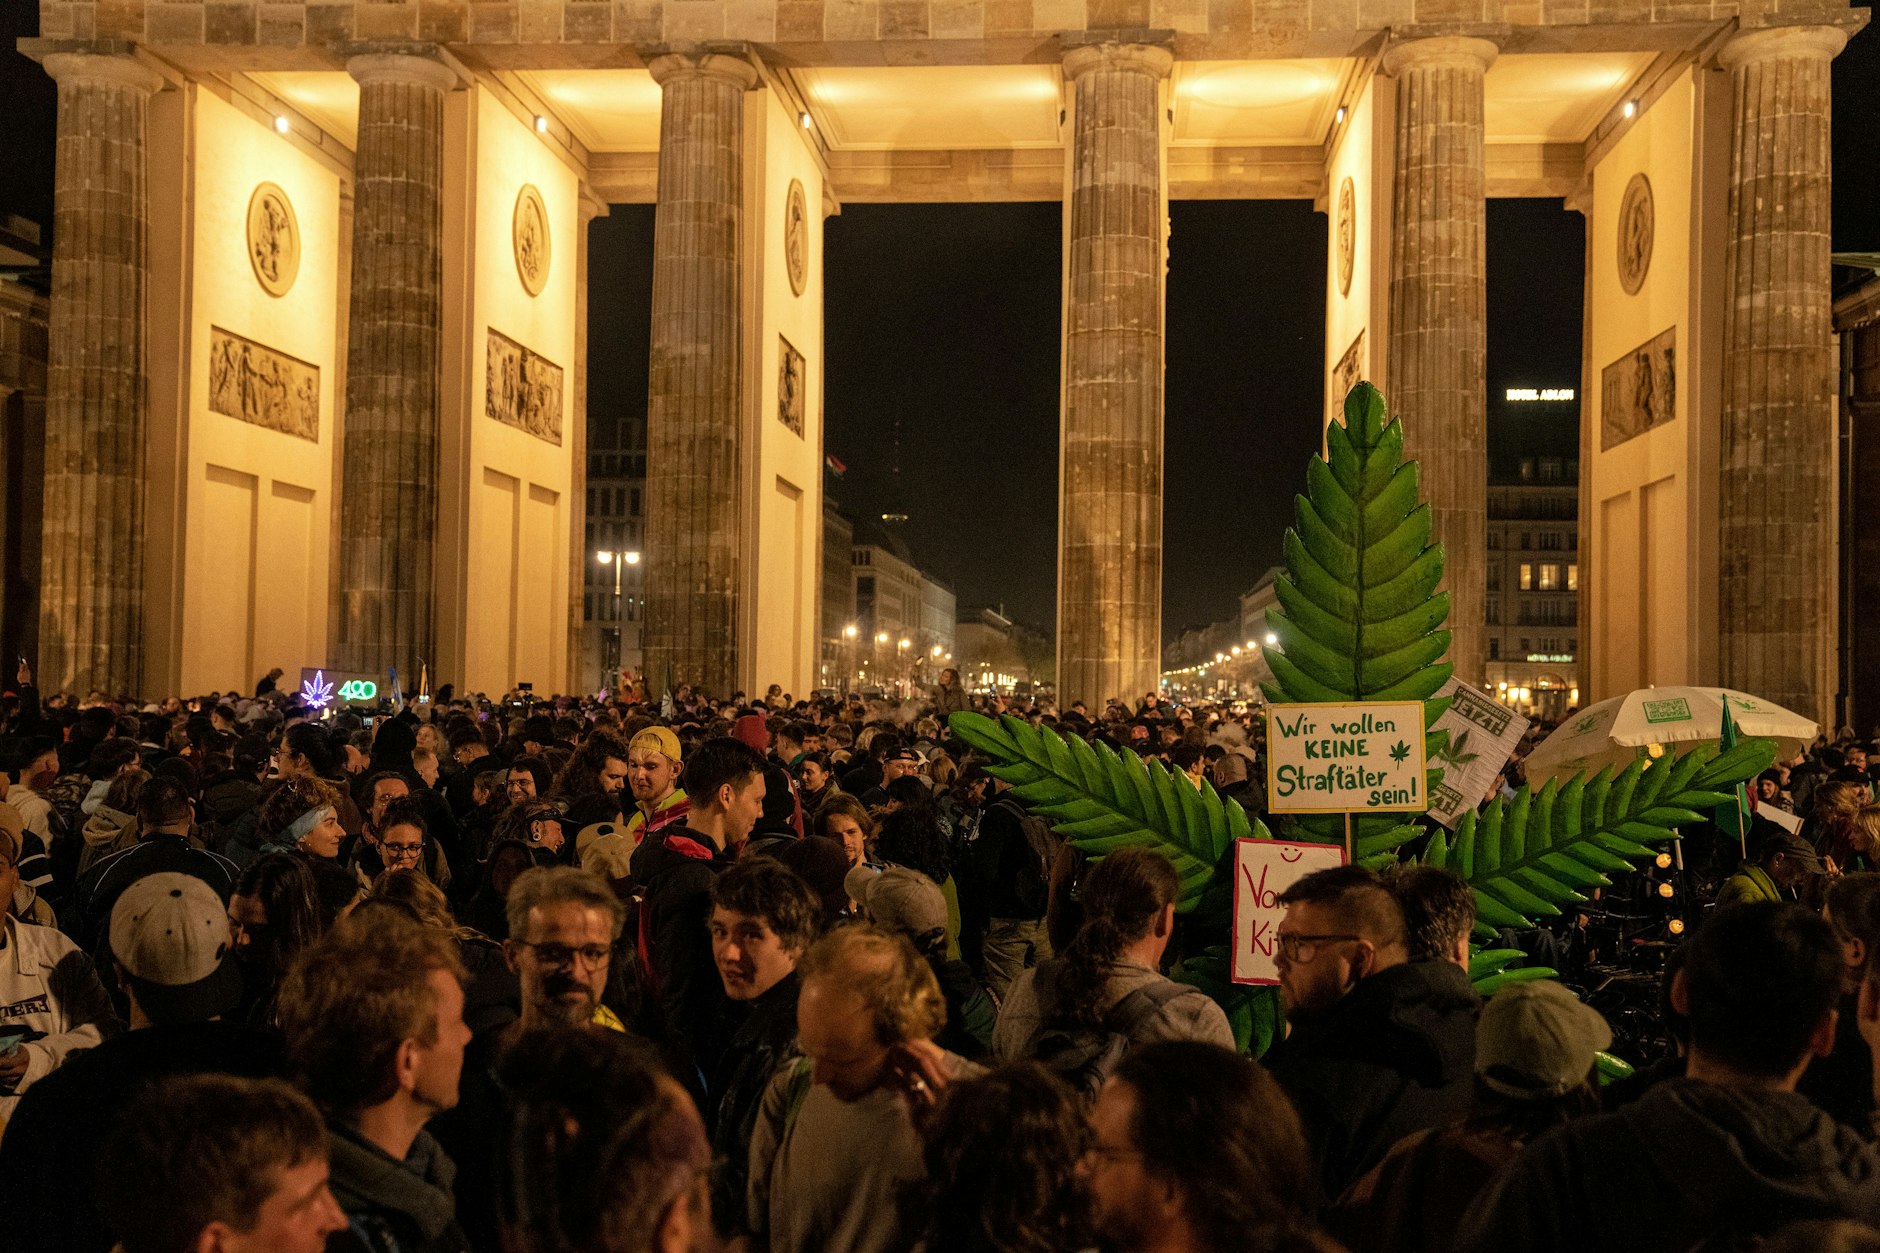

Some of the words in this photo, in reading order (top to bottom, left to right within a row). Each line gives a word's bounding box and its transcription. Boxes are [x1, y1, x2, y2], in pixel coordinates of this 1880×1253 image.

[337, 680, 377, 701] 420
[1457, 687, 1511, 722] CANNABISGESETZ
[1275, 713, 1317, 738] Wir
[1331, 713, 1396, 735] wollen
[1450, 696, 1506, 735] JETZT!
[1304, 739, 1370, 760] KEINE
[1276, 763, 1388, 798] Straftäter
[1367, 776, 1417, 807] sein!
[1251, 919, 1279, 957] Ki
